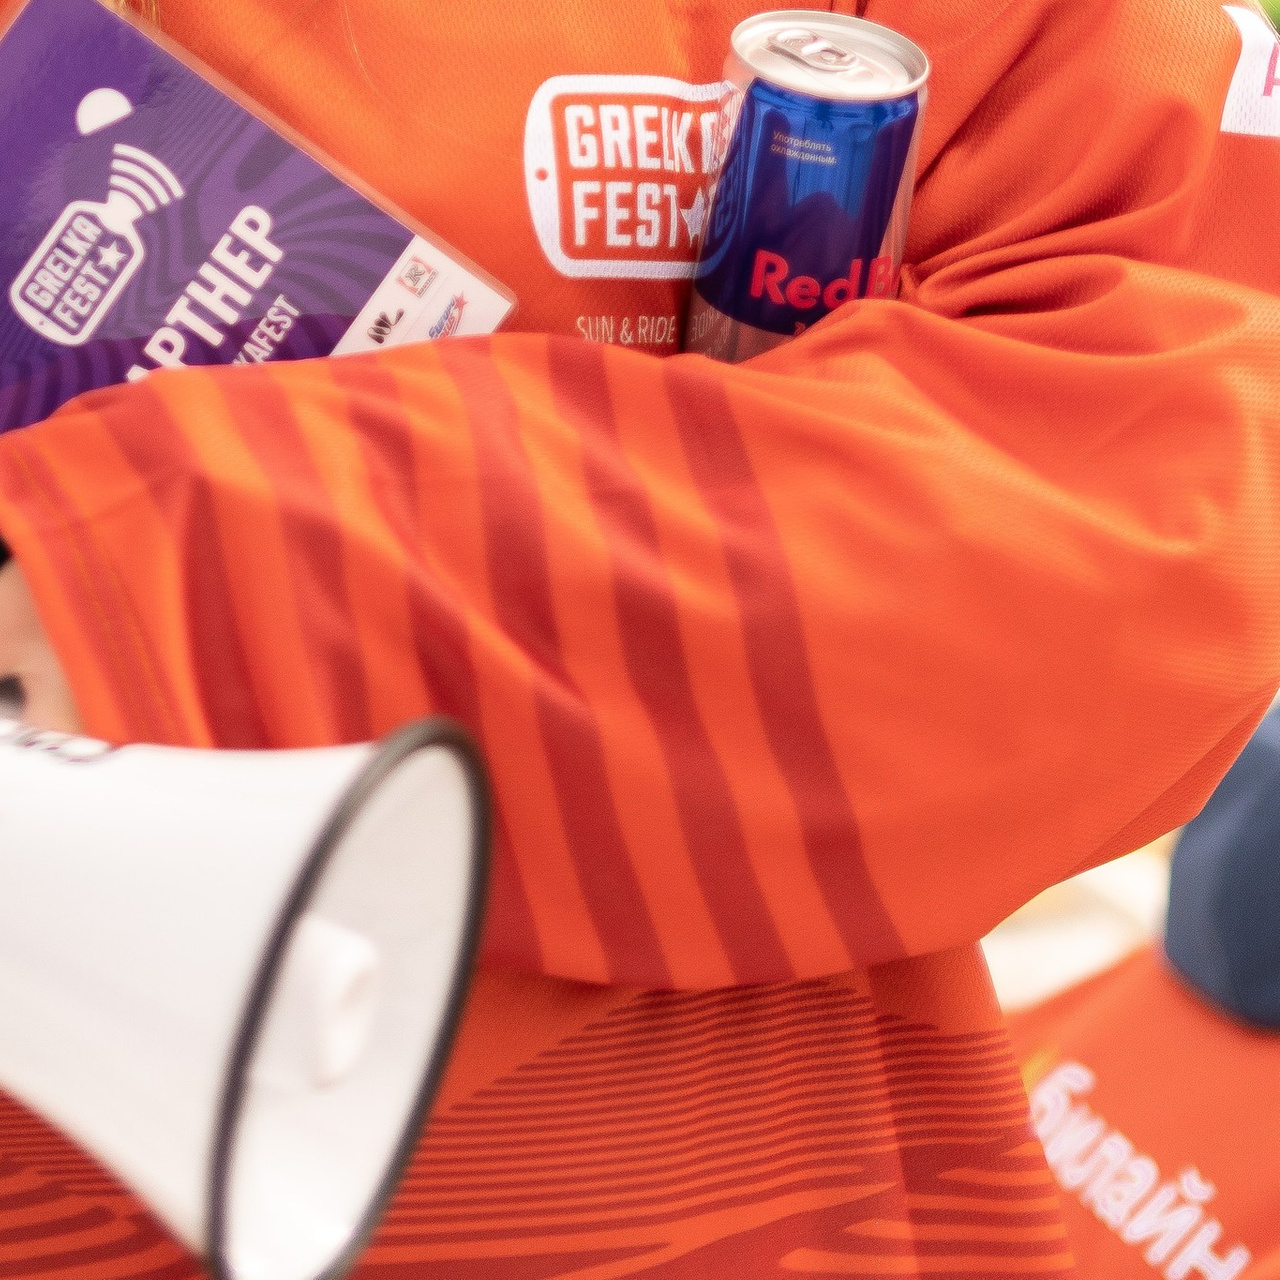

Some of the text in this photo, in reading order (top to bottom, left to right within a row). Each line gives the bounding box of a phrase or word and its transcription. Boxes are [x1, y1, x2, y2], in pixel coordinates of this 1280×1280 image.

[572, 180, 679, 248] FEST
[24, 214, 103, 310] GRELKA
[52, 260, 110, 330] FEST
[750, 247, 863, 311] Red
[576, 313, 614, 344] SUN
[638, 313, 676, 345] RIDE
[1030, 1061, 1252, 1280] билайн
